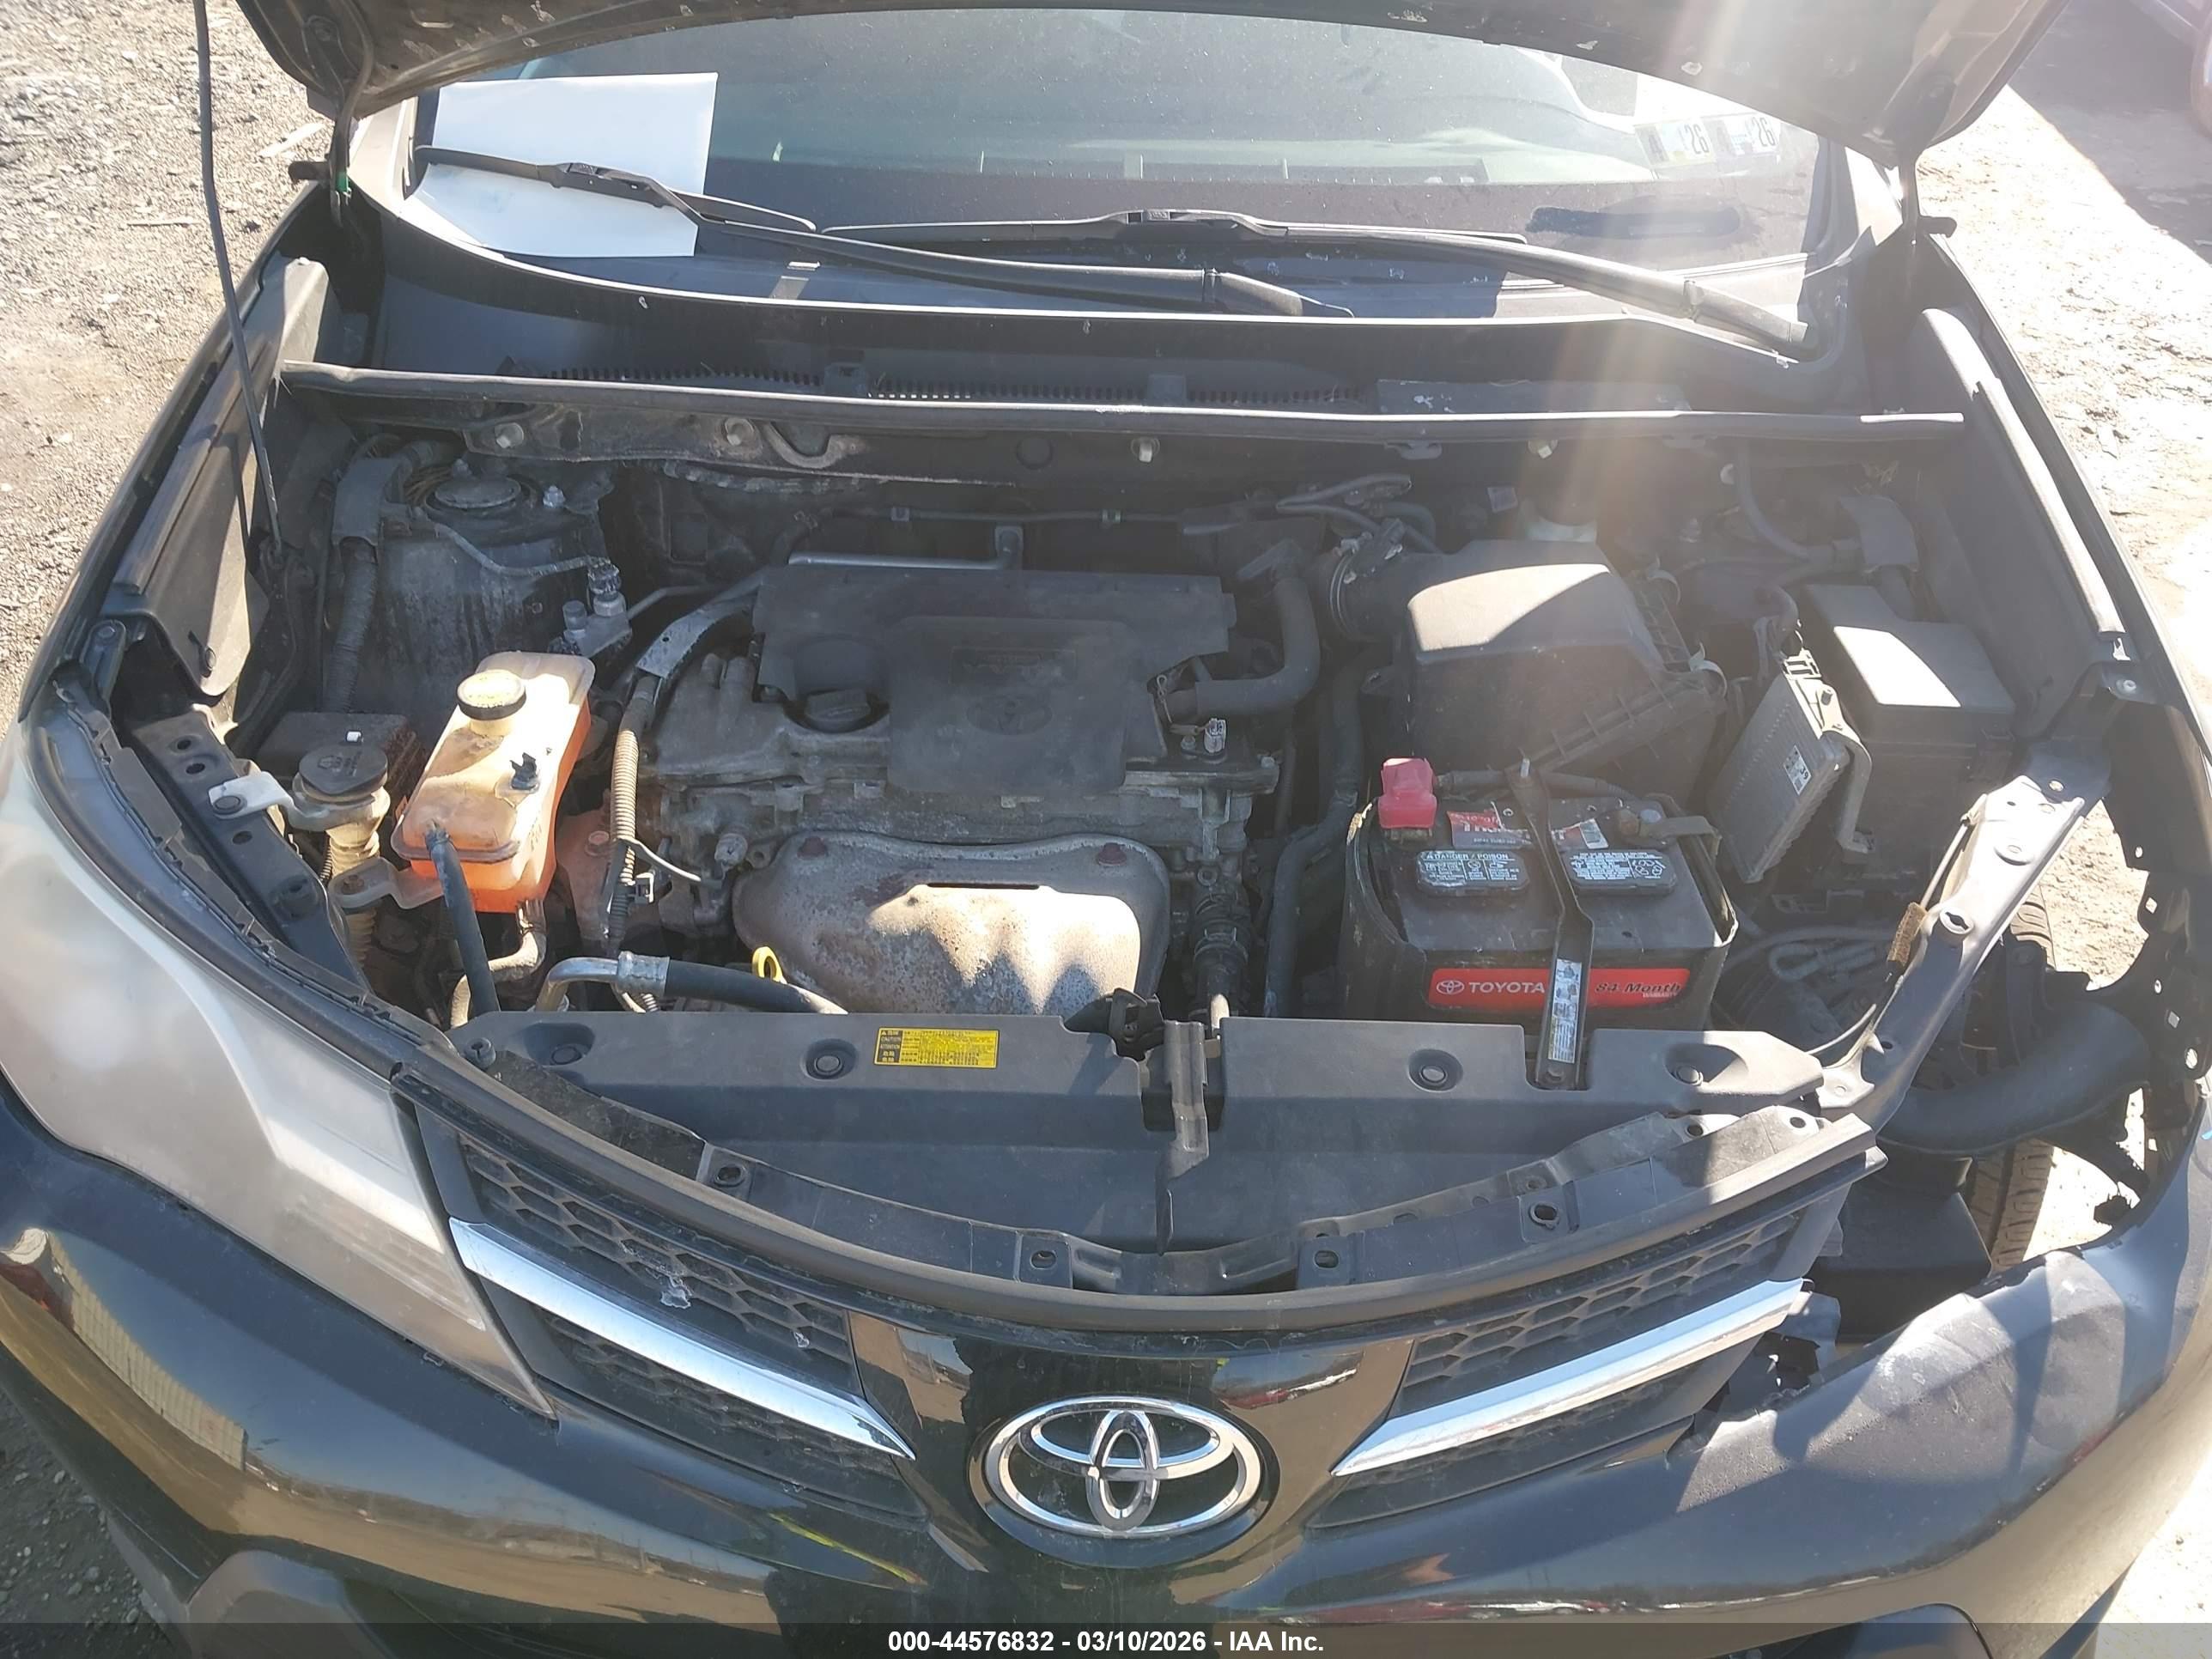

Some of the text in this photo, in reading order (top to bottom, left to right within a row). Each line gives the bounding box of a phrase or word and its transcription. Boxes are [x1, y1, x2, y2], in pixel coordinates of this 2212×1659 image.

[1684, 124, 1710, 155] 26
[1751, 116, 1777, 147] 26
[1468, 981, 1546, 994] TOYOTA
[1595, 981, 1681, 994] 84 Month
